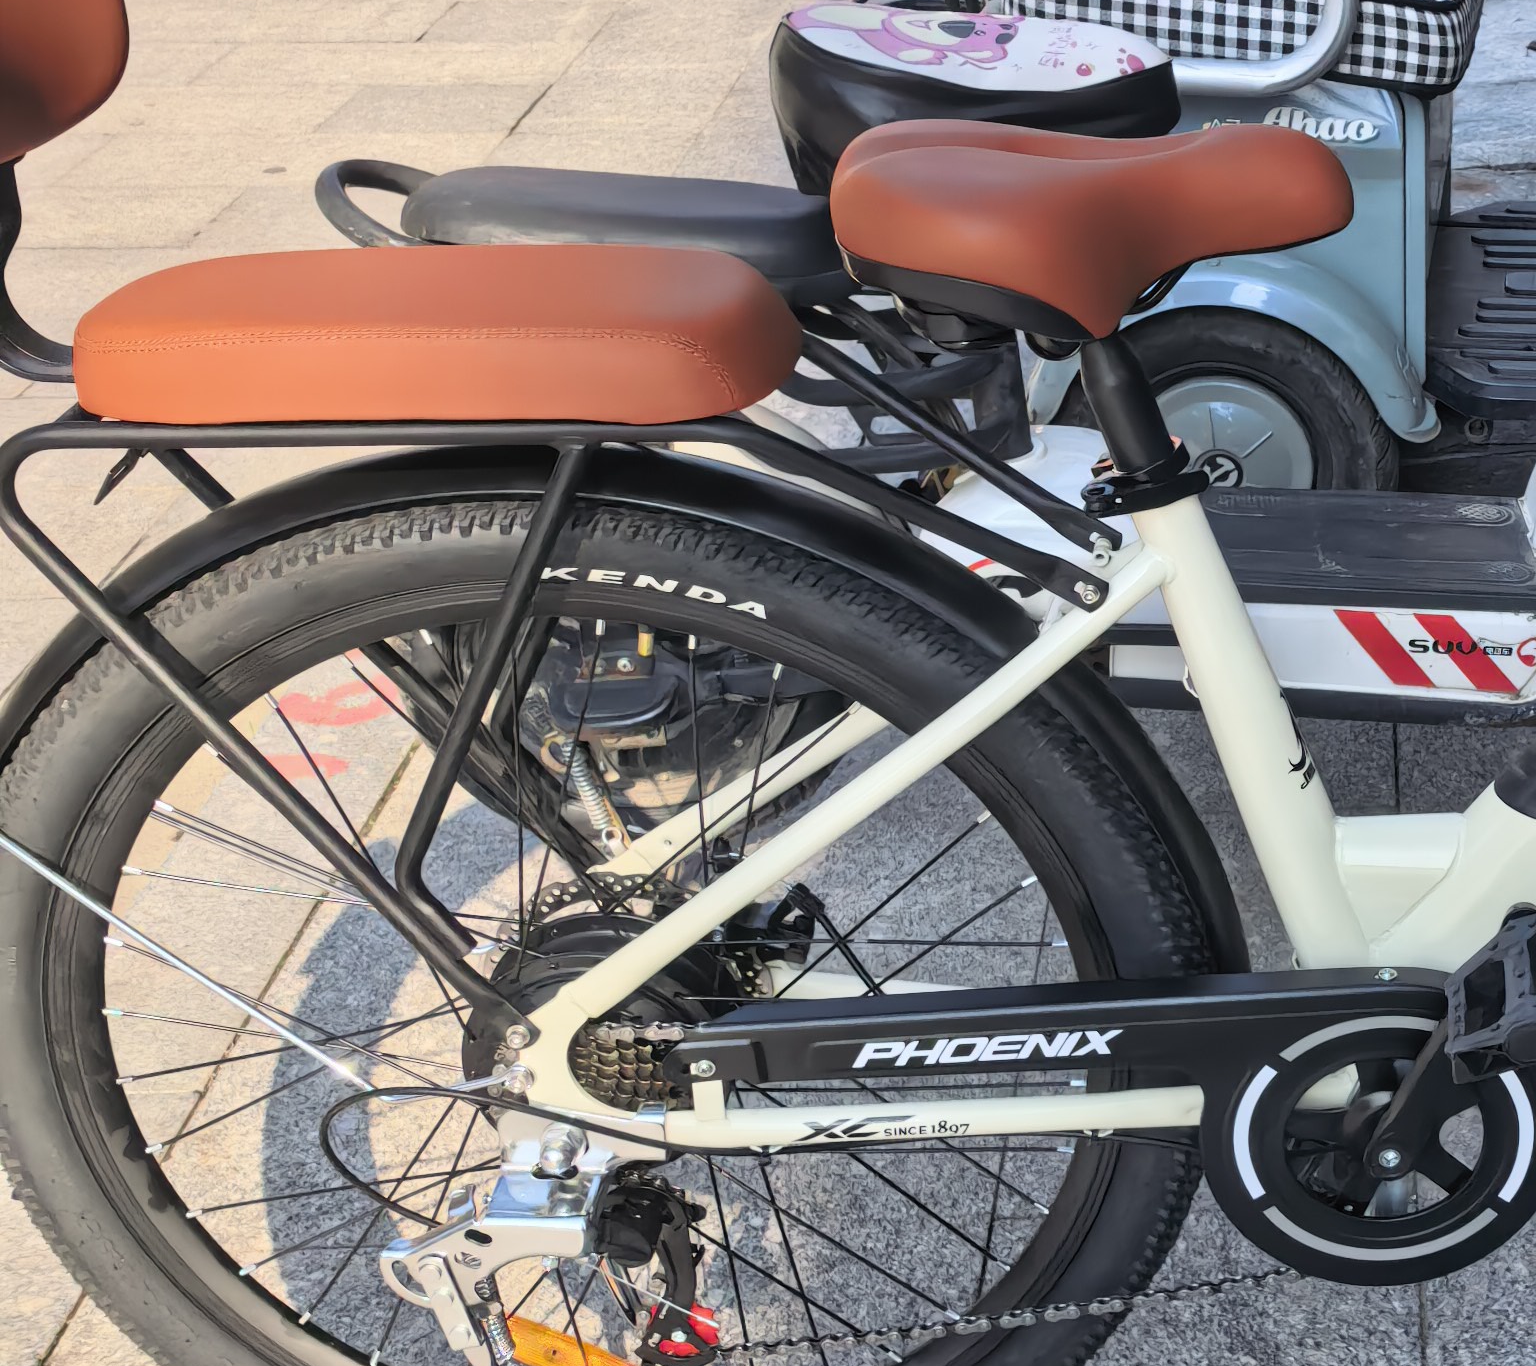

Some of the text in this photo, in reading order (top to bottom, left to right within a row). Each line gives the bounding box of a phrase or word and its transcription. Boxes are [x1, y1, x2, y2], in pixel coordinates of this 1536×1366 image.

[541, 567, 767, 619] KENDA
[852, 1029, 1123, 1068] PHOENIX
[883, 1125, 928, 1137] SINCE
[931, 1121, 970, 1135] 1897
